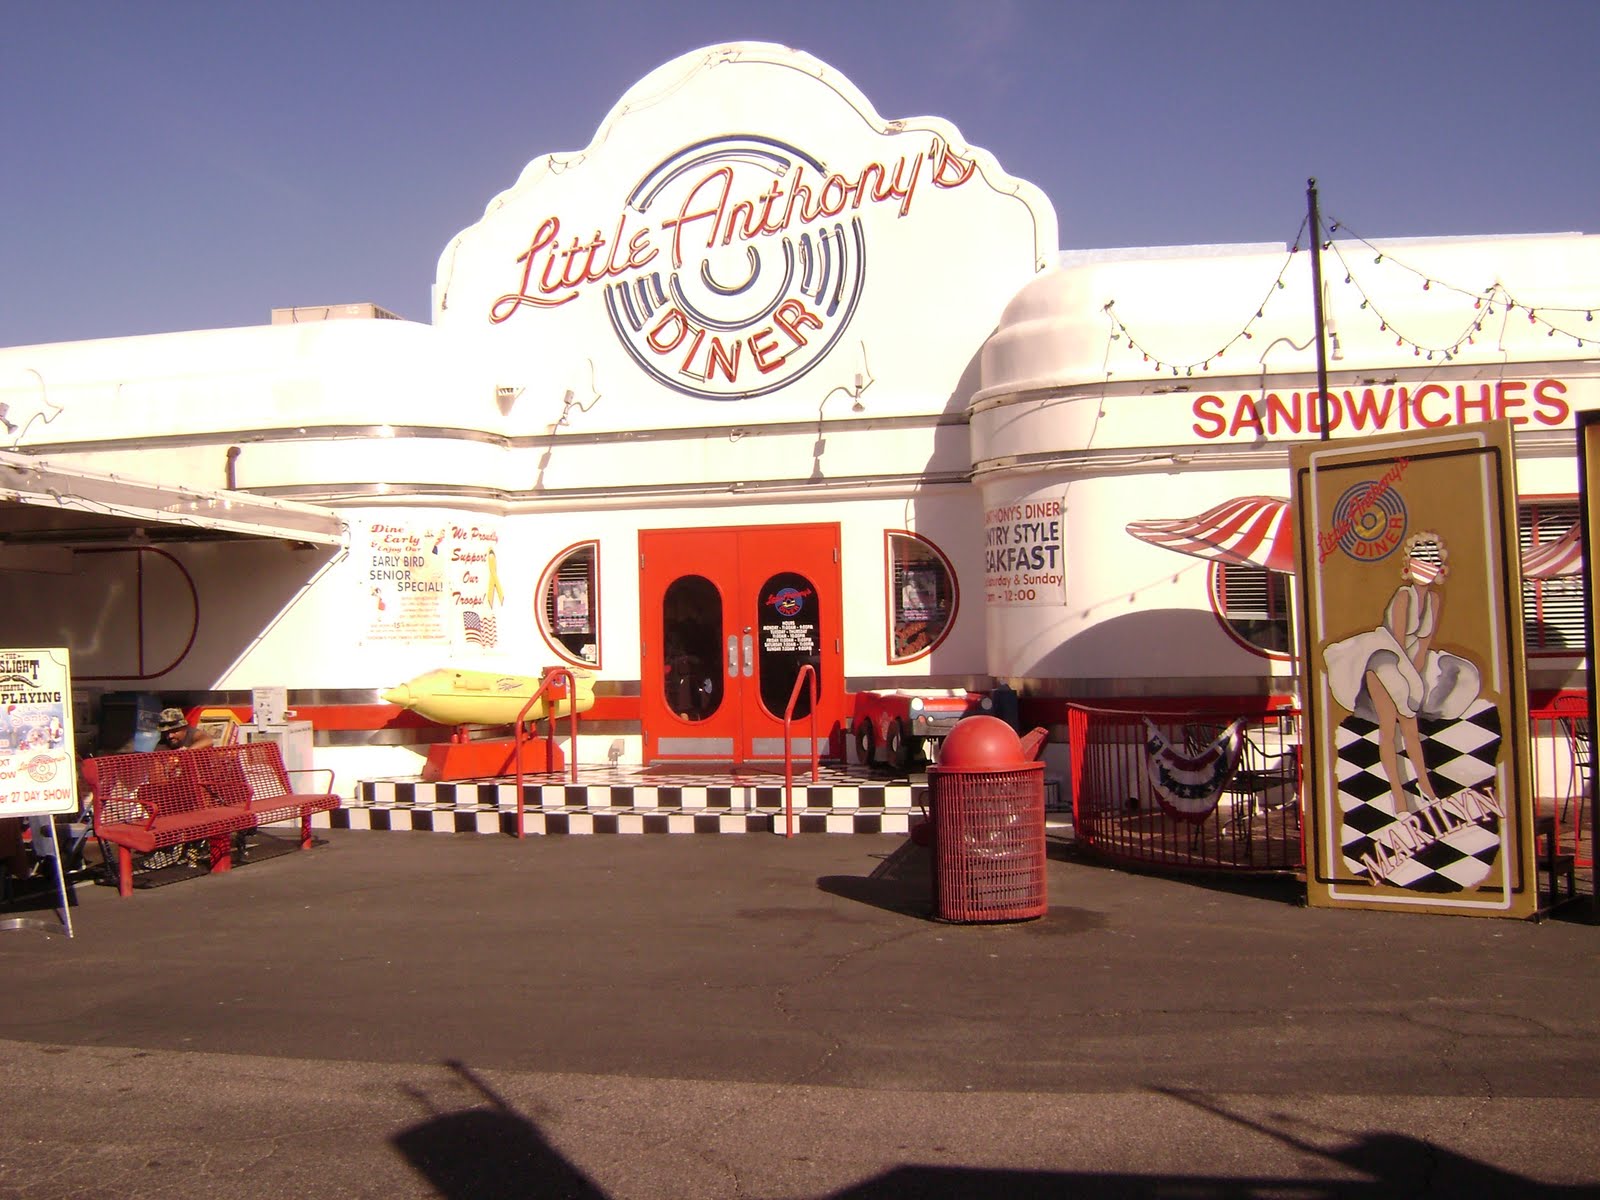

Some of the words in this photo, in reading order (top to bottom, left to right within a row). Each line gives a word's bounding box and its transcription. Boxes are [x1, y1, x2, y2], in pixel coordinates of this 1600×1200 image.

[489, 211, 659, 324] Little
[661, 138, 977, 269] Anthony's
[646, 298, 823, 383] DINER
[1192, 379, 1569, 439] SANDWICHES
[1025, 502, 1060, 519] DINER
[370, 525, 404, 533] Dine
[451, 526, 467, 540] We
[471, 527, 499, 544] Proudly
[1014, 522, 1059, 544] STYLE
[383, 535, 420, 546] Early
[1354, 517, 1403, 557] DINER
[372, 556, 400, 567] EARLY
[403, 556, 425, 567] BIRD
[451, 548, 487, 564] Support
[369, 570, 411, 580] SENIOR
[463, 571, 479, 584] Our
[1014, 575, 1020, 585] &
[1023, 573, 1063, 587] Sunday
[397, 582, 444, 592] SPECIAL!
[452, 591, 487, 608] Troops!
[1003, 589, 1036, 601] 12:00
[1, 692, 62, 704] PLAYING
[0, 759, 10, 767] XT
[11, 791, 20, 803] 27
[23, 791, 40, 802] DAY
[43, 789, 71, 801] SHOW
[1360, 786, 1506, 887] MARILYN
